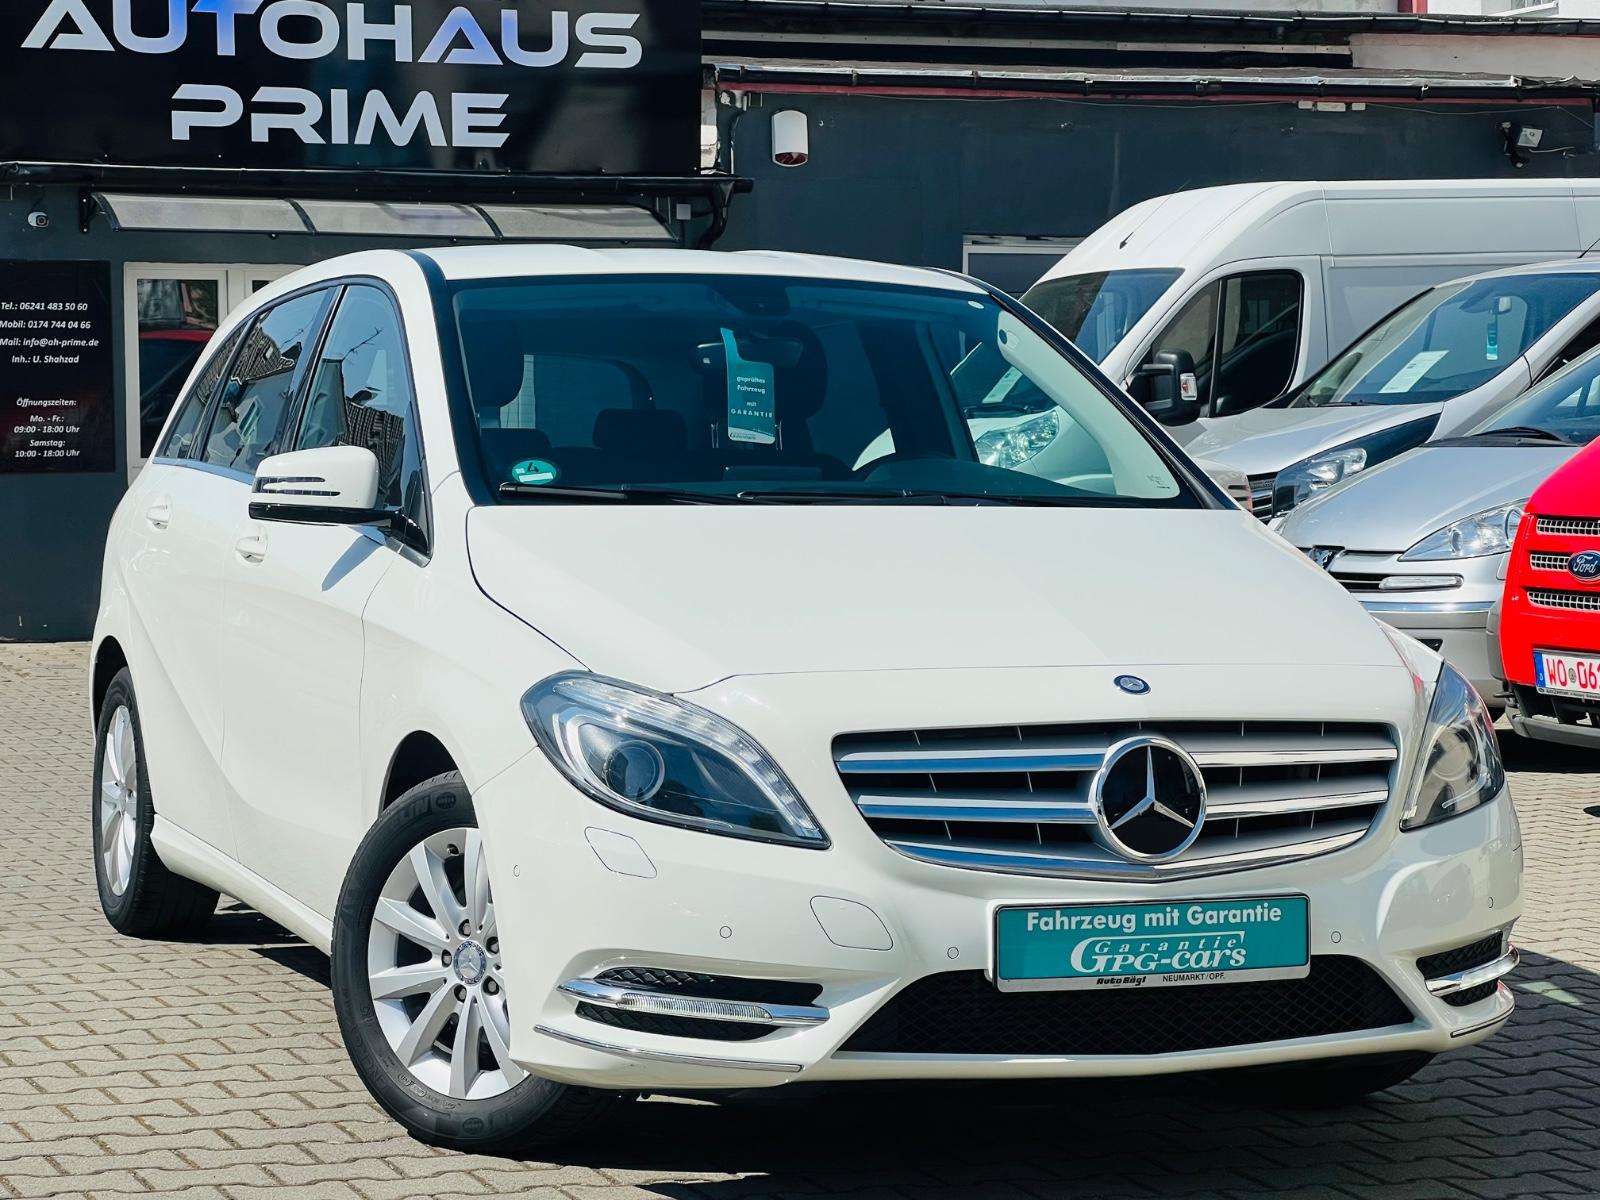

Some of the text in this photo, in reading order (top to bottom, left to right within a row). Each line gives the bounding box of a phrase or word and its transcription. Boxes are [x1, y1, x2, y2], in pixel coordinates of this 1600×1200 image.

[20, 0, 642, 69] AUTOHAUS
[171, 83, 510, 148] PRIME
[1, 301, 88, 312] Tel.: 06241 483 50 60
[0, 320, 91, 330] Mobil: 0174 744 04 66
[0, 338, 100, 348] Mail: info@ah-prime.de
[11, 355, 79, 364] Inh.: U. Shahzad
[16, 397, 77, 408] Öffnungszeiten:
[730, 408, 773, 418] GARANTIE
[29, 415, 46, 423] Mo.
[52, 415, 65, 423] Fr.:
[13, 425, 37, 434] 09:00
[42, 425, 64, 434] 18:00
[65, 425, 80, 433] Uhr
[29, 439, 66, 448] Samstag:
[14, 450, 37, 458] 10:00
[42, 450, 65, 458] 18:00
[66, 449, 80, 457] Uhr
[1572, 554, 1599, 574] Ford
[1545, 658, 1568, 687] WO
[1027, 902, 1282, 933] Fahrzeug mit Garantie
[1094, 935, 1237, 954] Garantie
[1070, 932, 1246, 973] GPG-cars
